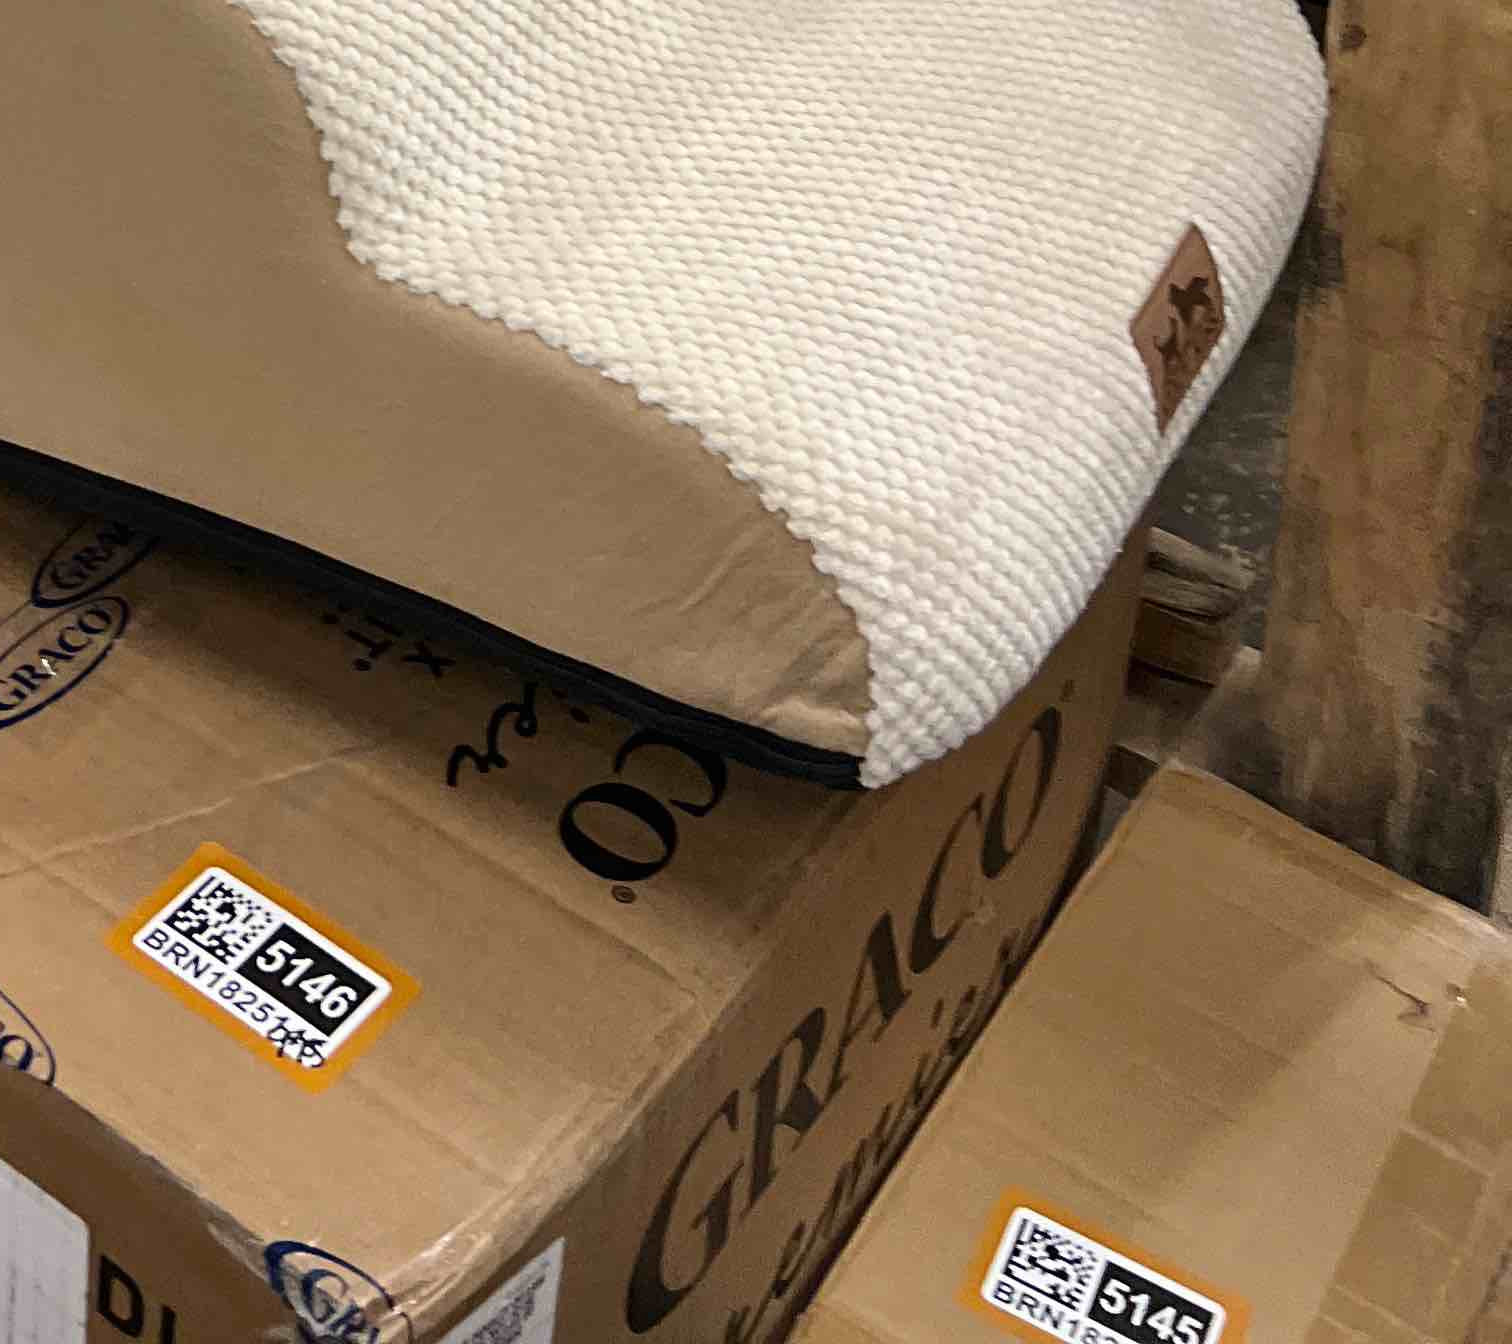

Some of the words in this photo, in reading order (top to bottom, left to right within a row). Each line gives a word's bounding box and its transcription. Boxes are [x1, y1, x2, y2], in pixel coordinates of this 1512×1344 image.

[254, 939, 358, 1020] 5146
[625, 704, 1063, 1334] GRACO
[1099, 1278, 1204, 1344] 5145
